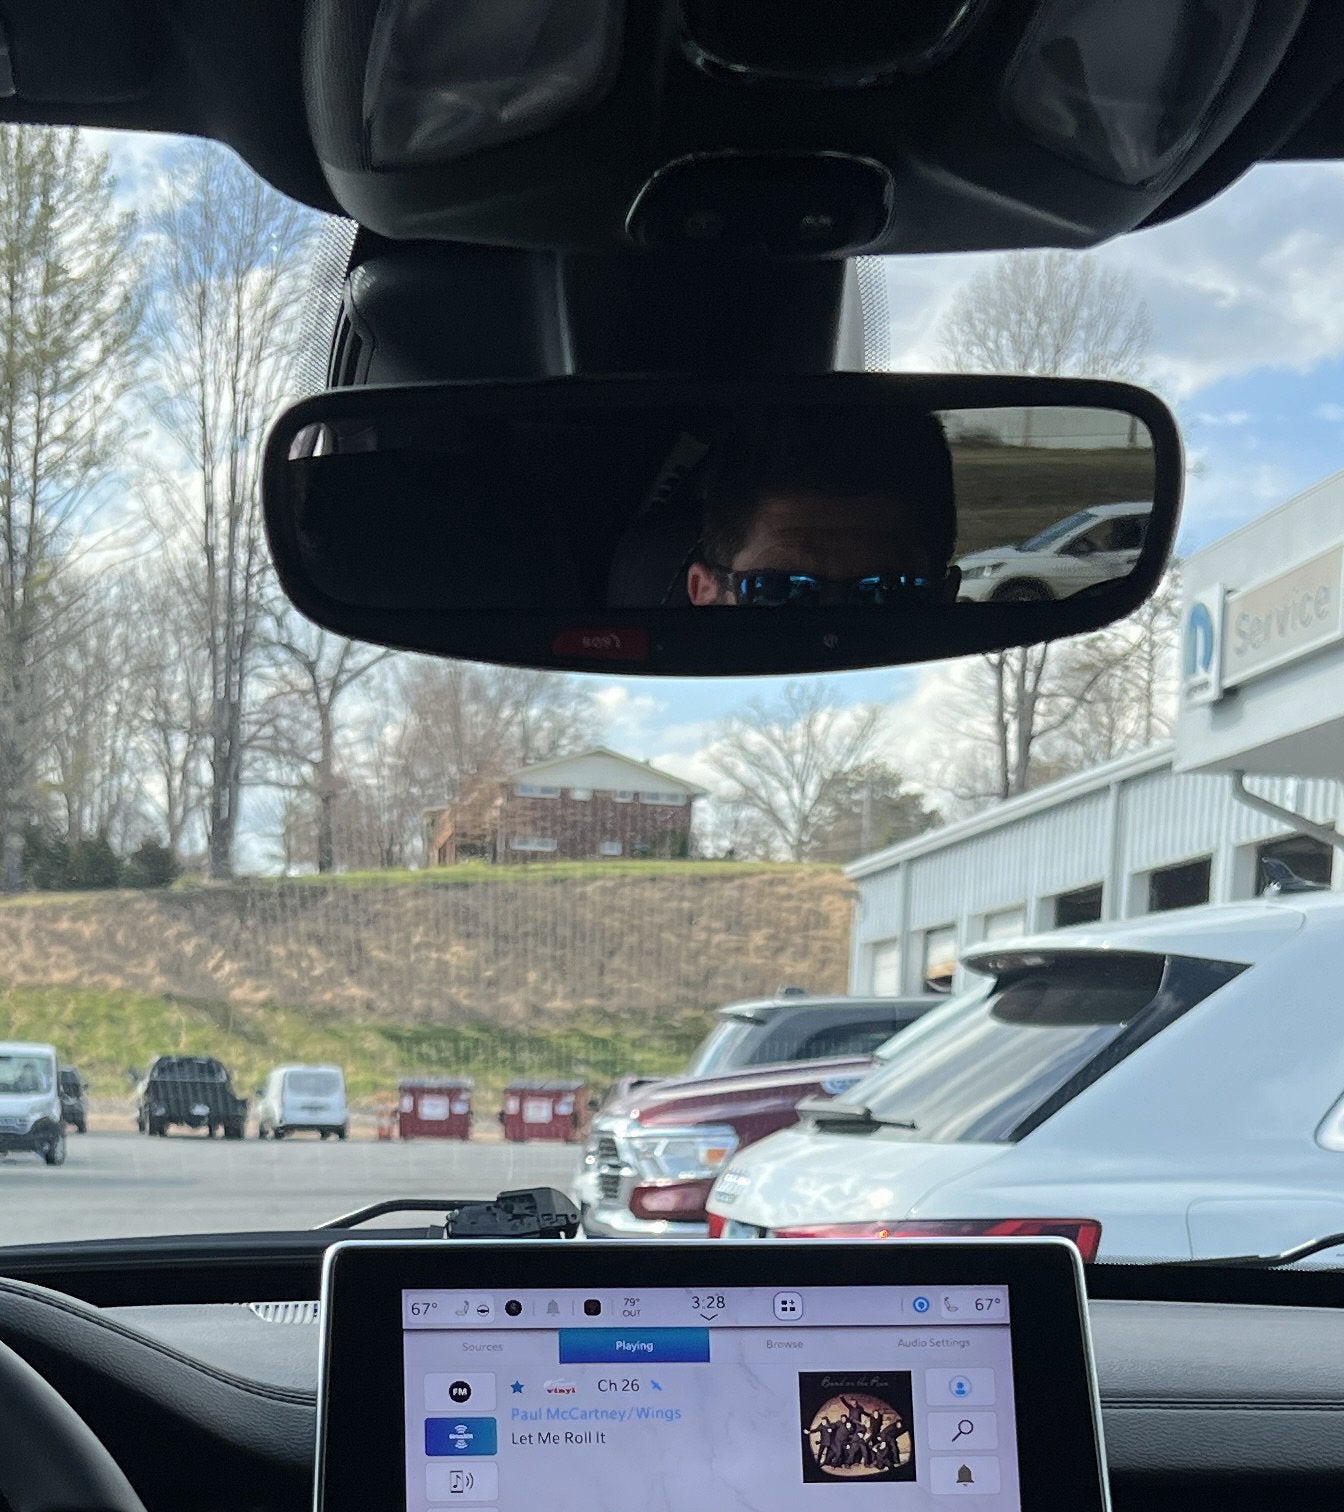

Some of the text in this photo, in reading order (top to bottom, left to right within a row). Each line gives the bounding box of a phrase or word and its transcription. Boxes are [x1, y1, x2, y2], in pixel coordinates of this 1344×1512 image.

[1234, 586, 1330, 657] Service
[623, 1297, 640, 1307] 79°
[691, 1296, 726, 1309] 3:28
[974, 1298, 1001, 1312] 67°
[411, 1302, 438, 1316] 67°
[623, 1309, 641, 1318] OUT
[462, 1342, 503, 1352] Sources
[615, 1341, 654, 1353] Playing
[766, 1339, 804, 1349] Browse
[898, 1338, 971, 1349] Audio Settings
[452, 1387, 468, 1396] FM
[598, 1379, 640, 1392] Ch 26
[511, 1408, 543, 1420] Paul
[511, 1431, 606, 1445] Let Me Roll It
